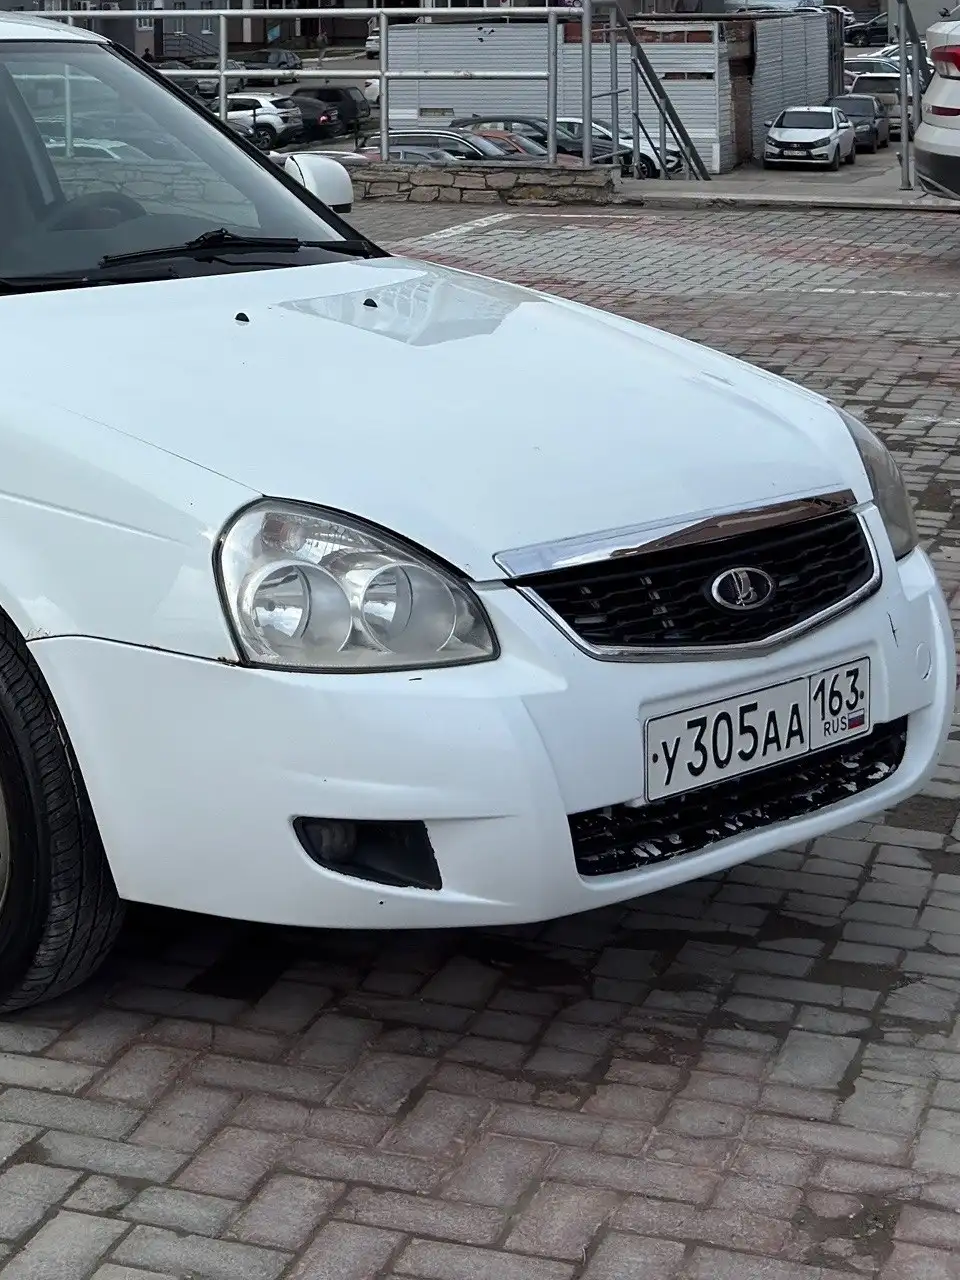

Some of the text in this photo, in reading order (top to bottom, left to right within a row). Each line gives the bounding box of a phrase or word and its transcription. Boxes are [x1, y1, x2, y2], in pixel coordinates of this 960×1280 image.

[661, 668, 860, 786] У305АА 163
[823, 713, 847, 737] RUS
